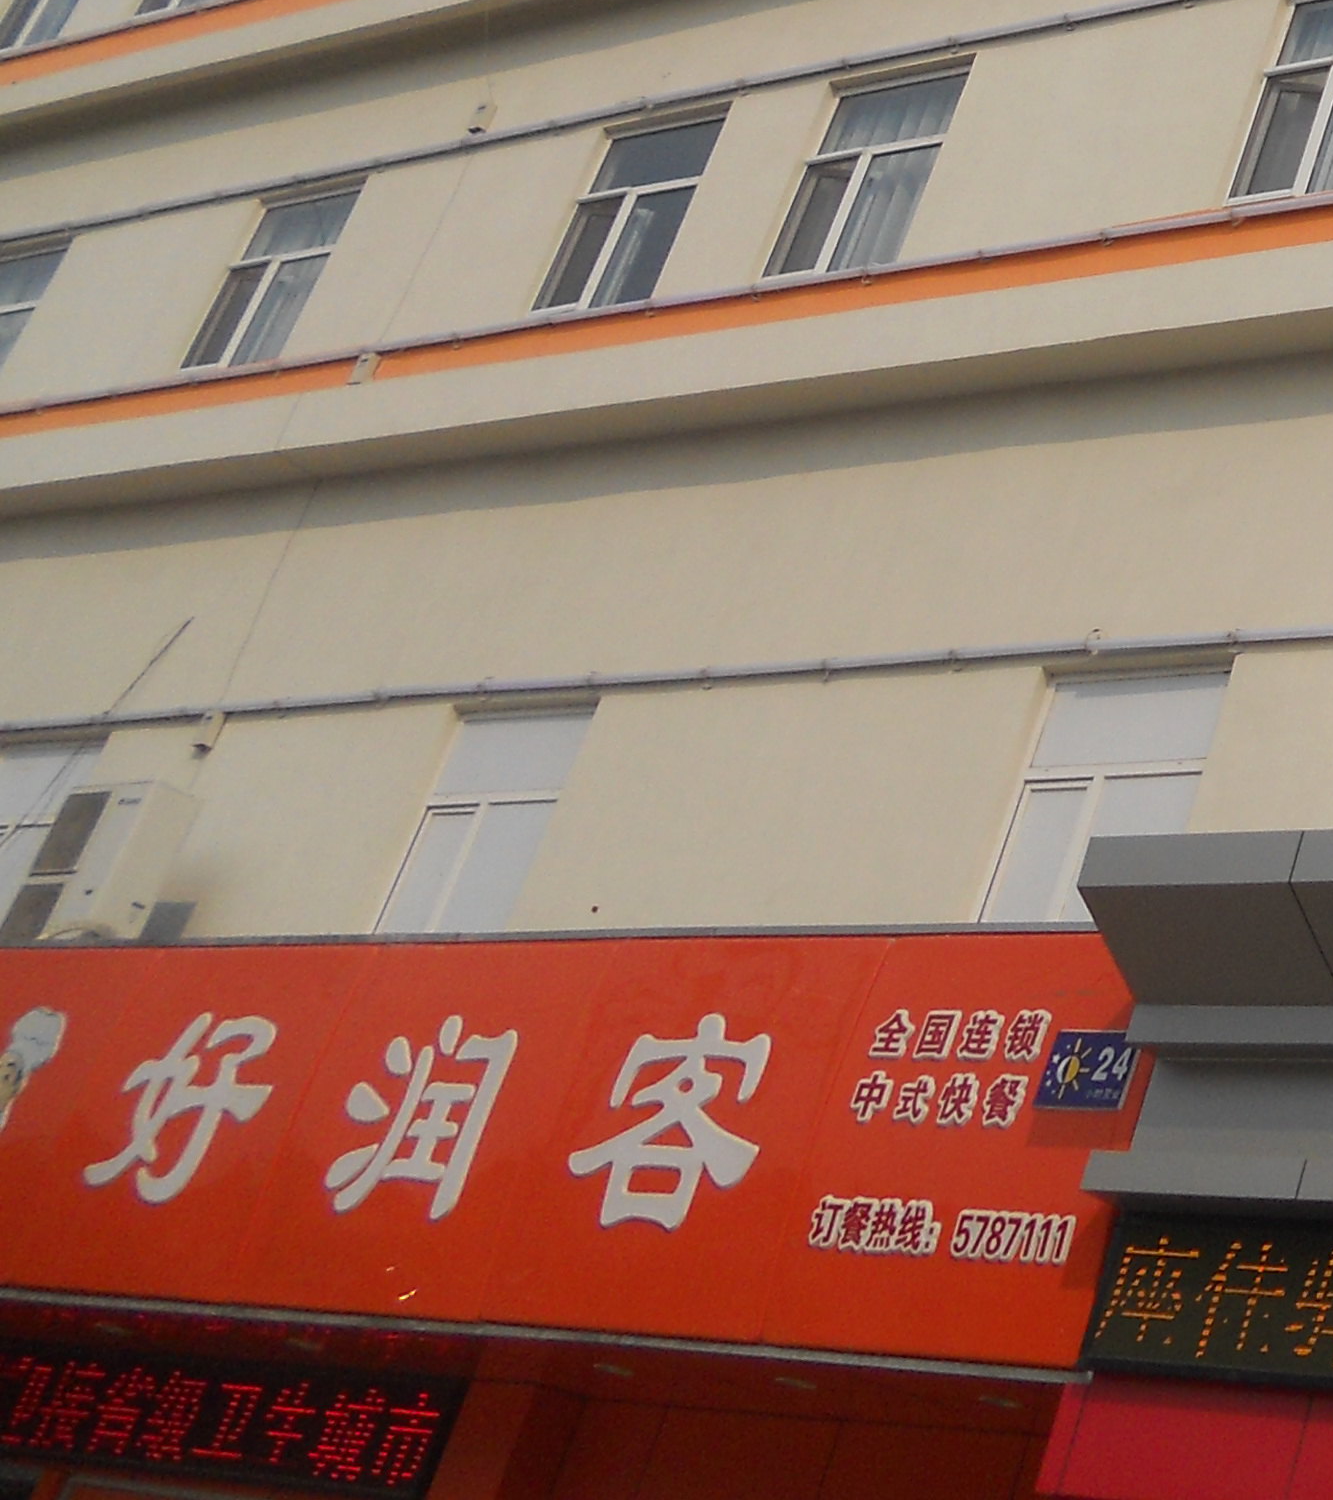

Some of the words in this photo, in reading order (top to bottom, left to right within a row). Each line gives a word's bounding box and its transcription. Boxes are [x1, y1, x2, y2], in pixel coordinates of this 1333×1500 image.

[868, 1008, 1052, 1063] 全国连锁
[1090, 1046, 1133, 1081] 24
[83, 1013, 774, 1232] 好润客
[850, 1070, 1029, 1129] 中式快餐
[950, 1208, 1077, 1265] 5787111
